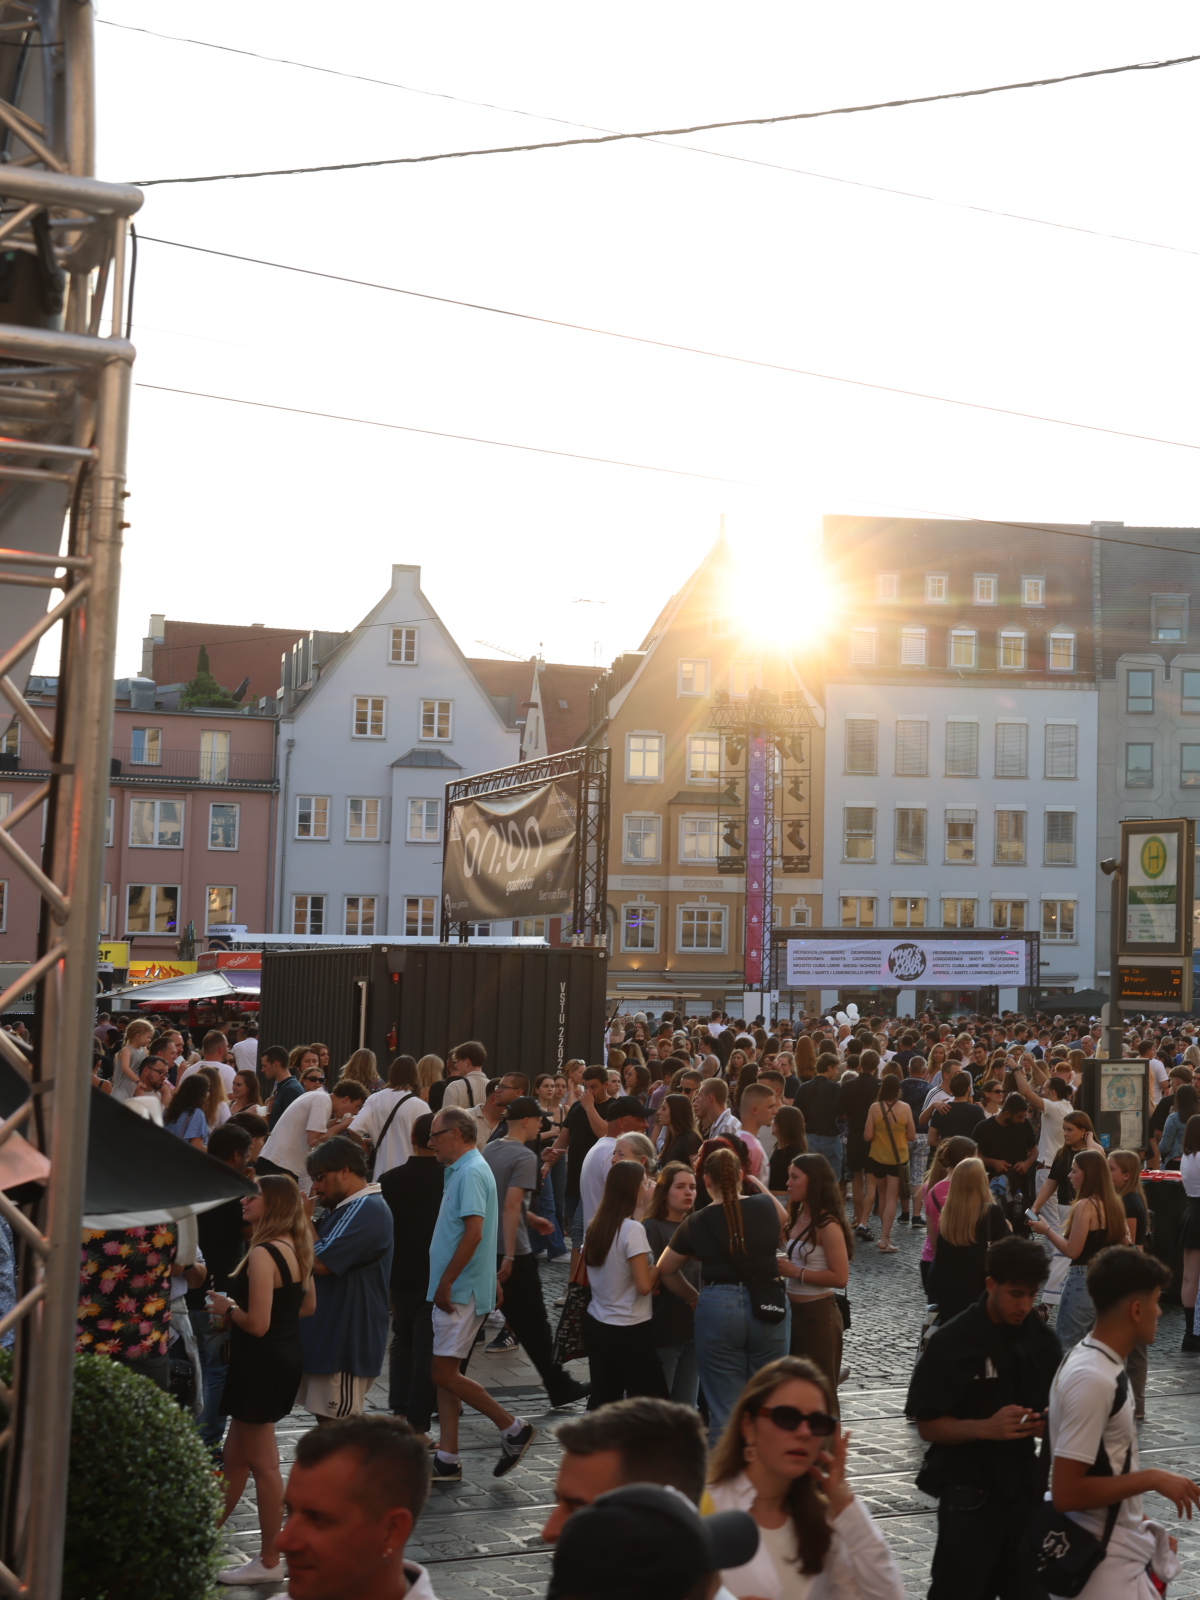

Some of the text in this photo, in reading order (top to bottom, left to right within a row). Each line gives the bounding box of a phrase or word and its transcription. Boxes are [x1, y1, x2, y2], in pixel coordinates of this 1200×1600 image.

[506, 875, 534, 896] gastrobar
[1136, 890, 1169, 900] Rathausplatz
[1128, 930, 1132, 939] 2
[761, 1304, 785, 1313] adidas
